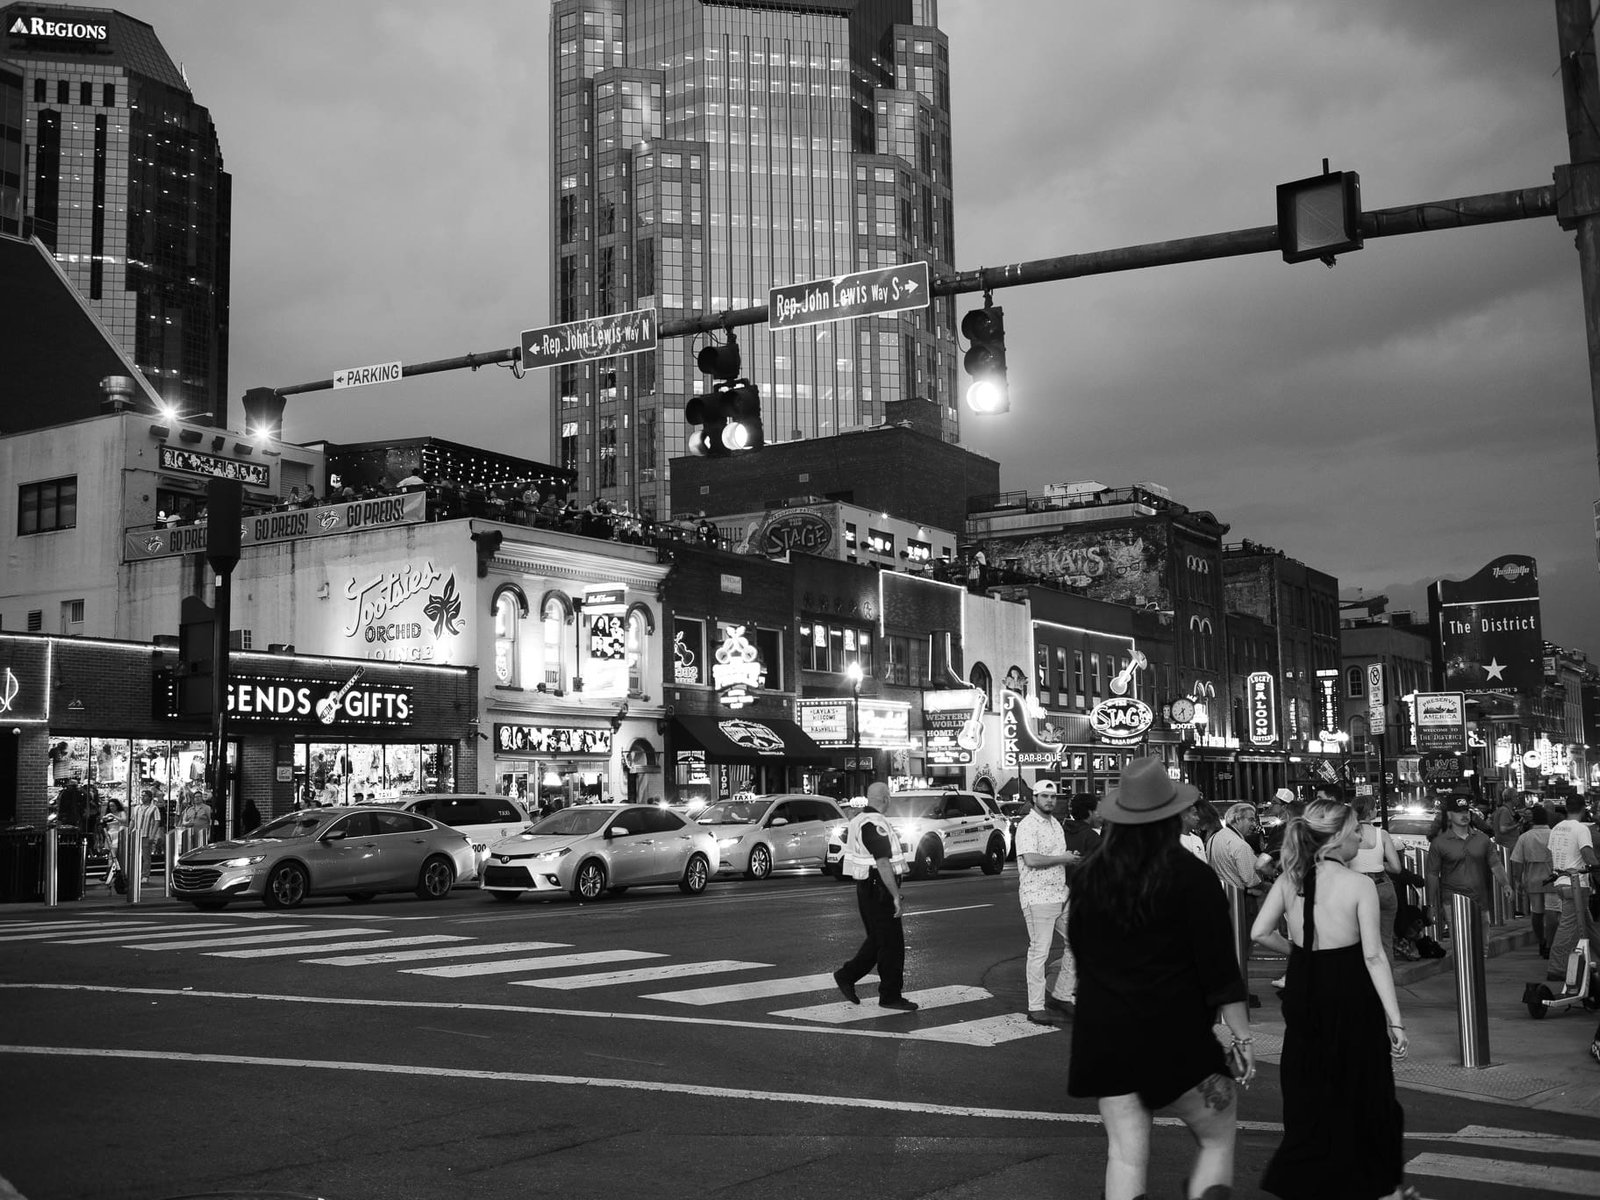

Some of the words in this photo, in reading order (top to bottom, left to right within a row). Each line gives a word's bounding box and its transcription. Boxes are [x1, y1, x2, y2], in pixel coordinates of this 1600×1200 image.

[31, 17, 107, 40] REGIONS
[776, 293, 801, 318] Rep.
[802, 291, 829, 313] John
[832, 283, 867, 309] Lewis
[871, 286, 889, 304] Way
[892, 276, 900, 298] S
[543, 333, 564, 357] Rep.
[565, 331, 589, 352] John
[591, 324, 621, 348] Lewis
[625, 324, 639, 343] Way
[642, 318, 650, 341] N
[347, 364, 399, 386] PARKING
[347, 505, 363, 527] GO
[364, 498, 405, 524] PREDS!
[255, 521, 270, 541] GO
[271, 514, 308, 538] PREDS!
[766, 524, 827, 553] STAGE
[170, 531, 183, 551] GO
[365, 622, 422, 643] ORCHID
[1449, 620, 1471, 634] The
[1481, 615, 1536, 633] District
[345, 690, 409, 719] GIFTS
[1254, 682, 1269, 736] SALOON
[1422, 696, 1457, 708] PRESERVE
[925, 712, 971, 721] WESTERN
[932, 720, 965, 728] WORLD
[1095, 704, 1151, 731] STAGE
[927, 729, 954, 737] HOME
[1003, 696, 1020, 766] JACKS
[1433, 733, 1462, 741] DISTRICT
[1019, 753, 1062, 762] BAR-B-QUE
[1425, 758, 1460, 771] LIVE
